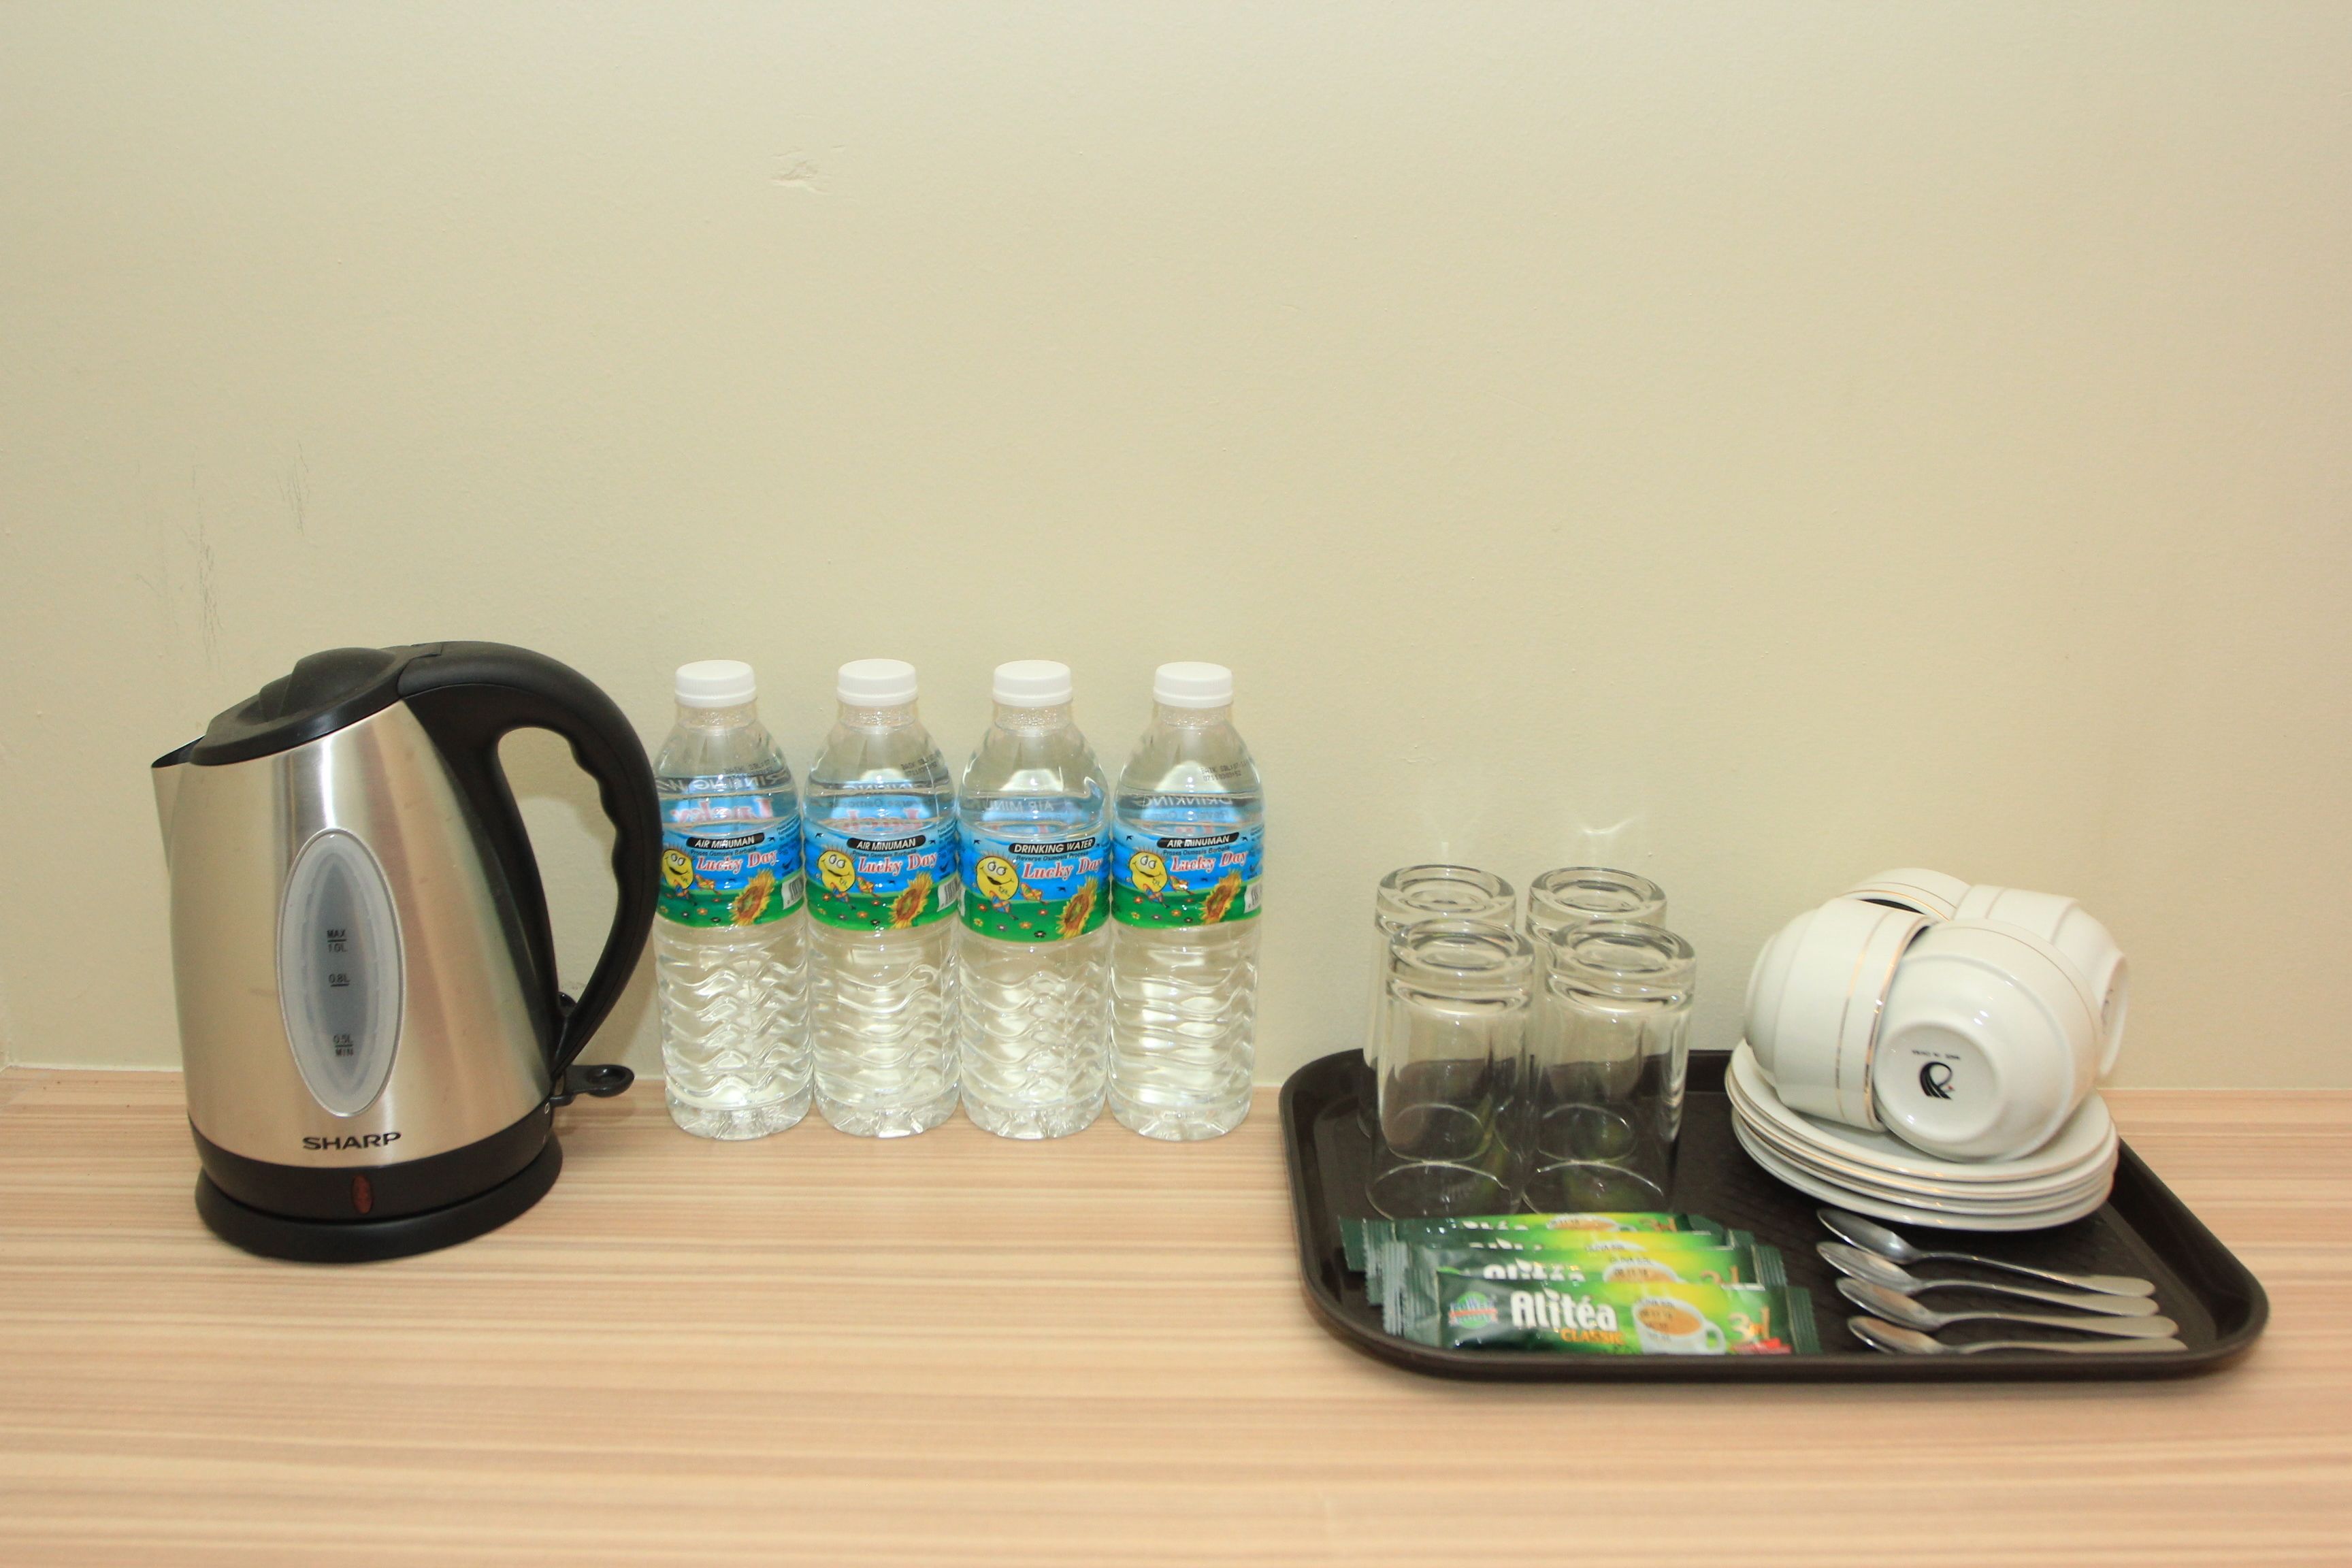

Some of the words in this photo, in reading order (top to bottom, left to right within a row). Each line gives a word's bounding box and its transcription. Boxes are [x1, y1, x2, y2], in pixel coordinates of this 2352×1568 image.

[694, 839, 709, 848] AIR
[857, 840, 870, 851] AIR
[871, 838, 916, 851] MINUMAN
[1014, 844, 1063, 853] DRINKING
[1066, 838, 1094, 851] WATER
[1166, 839, 1184, 848] AIR
[1185, 835, 1230, 847] MINUMAN
[696, 856, 742, 874] Lucky
[747, 850, 777, 868] Day
[858, 856, 902, 876] Lucky
[907, 852, 937, 871] Day
[1022, 861, 1073, 881] Lucky
[1076, 857, 1102, 875] Day
[1171, 855, 1216, 872] Lucky
[1220, 850, 1248, 867] Day
[327, 929, 346, 938] MAX
[335, 1048, 354, 1057] MIN
[303, 1132, 402, 1150] SHARP
[1512, 1286, 1618, 1332] Alitéa
